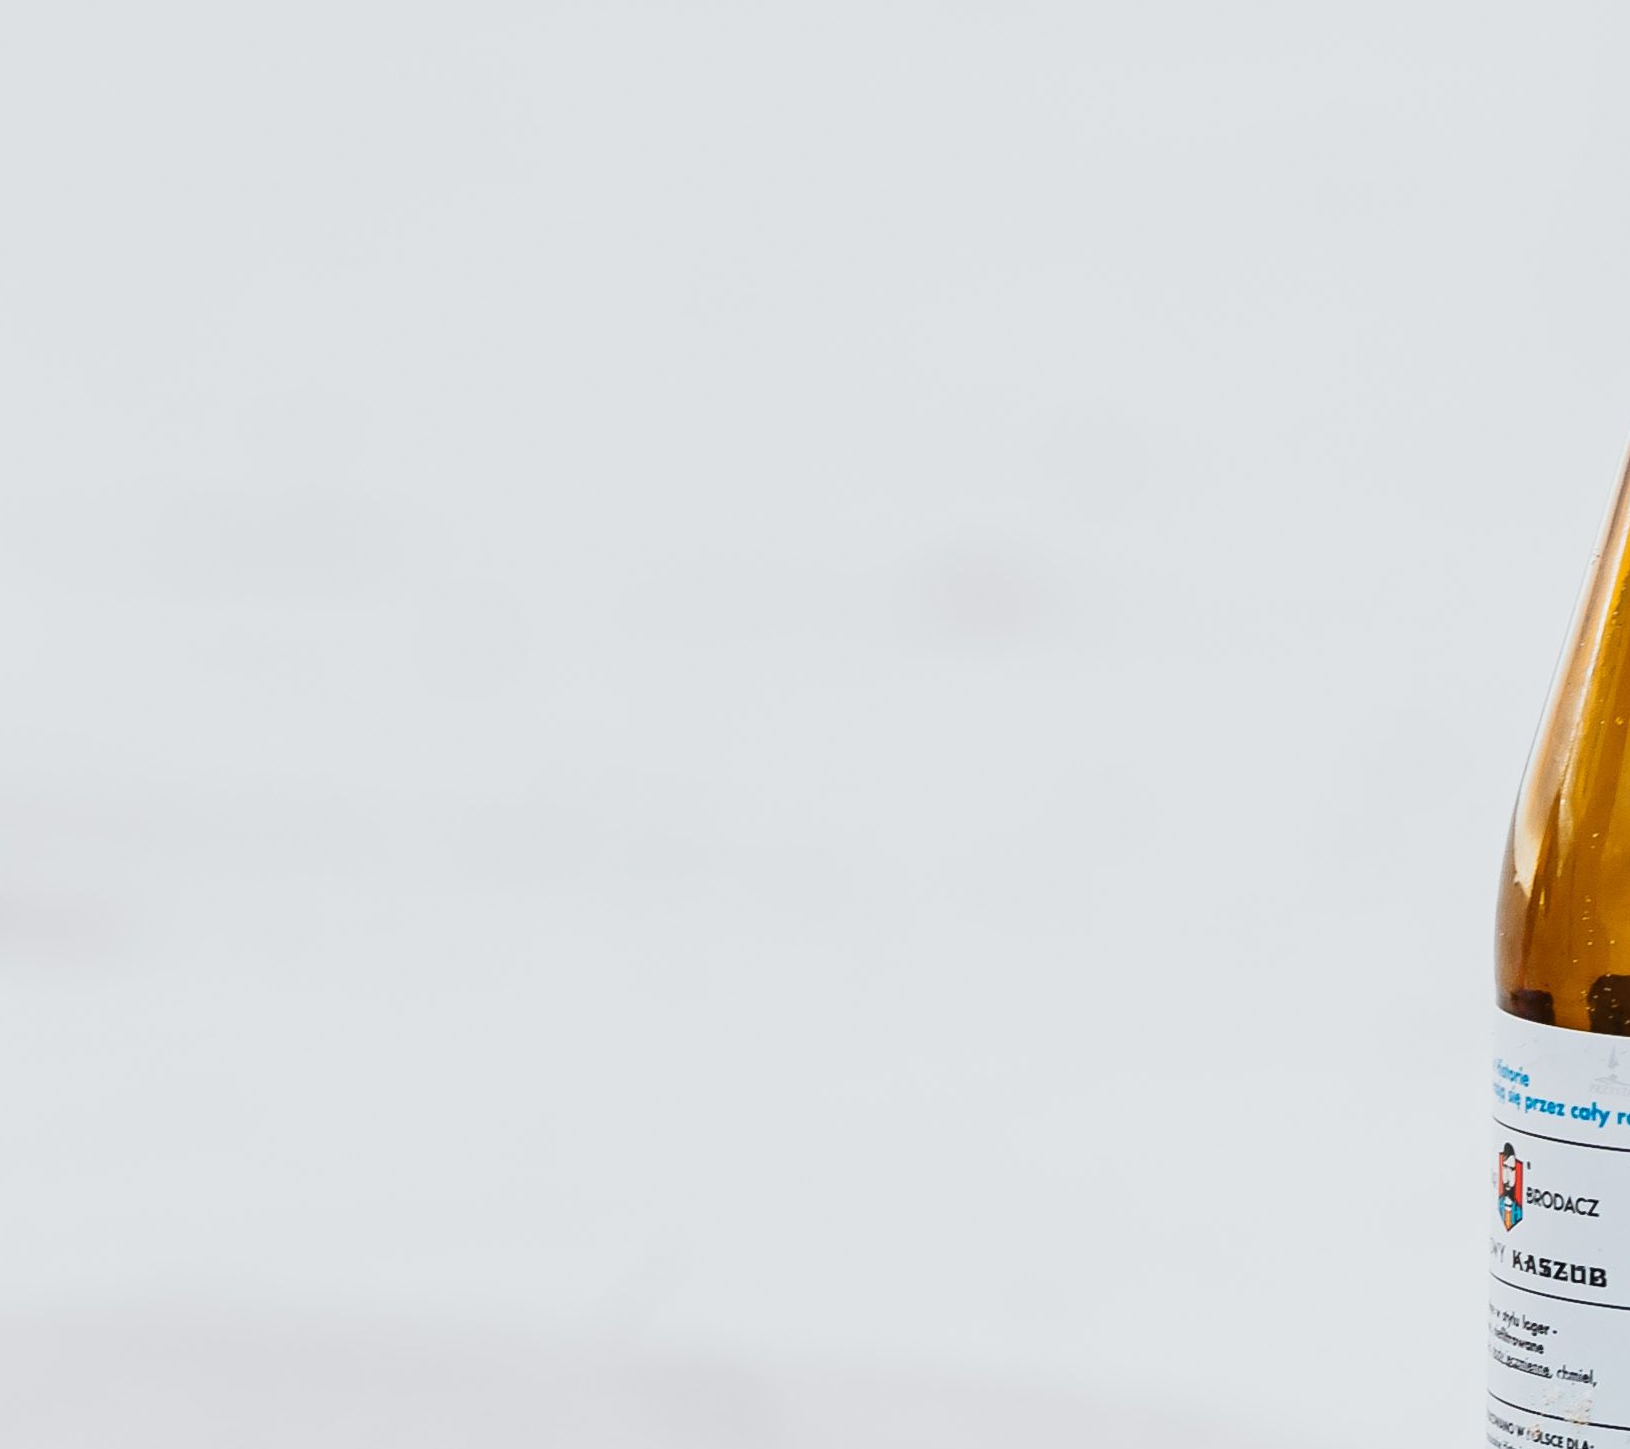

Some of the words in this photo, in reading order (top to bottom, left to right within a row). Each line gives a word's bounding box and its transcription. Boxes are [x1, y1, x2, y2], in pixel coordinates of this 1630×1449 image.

[1525, 1095, 1565, 1115] przez
[1571, 1102, 1610, 1128] cały
[1526, 1186, 1600, 1217] BRODACZ
[1512, 1249, 1607, 1288] KASZUB
